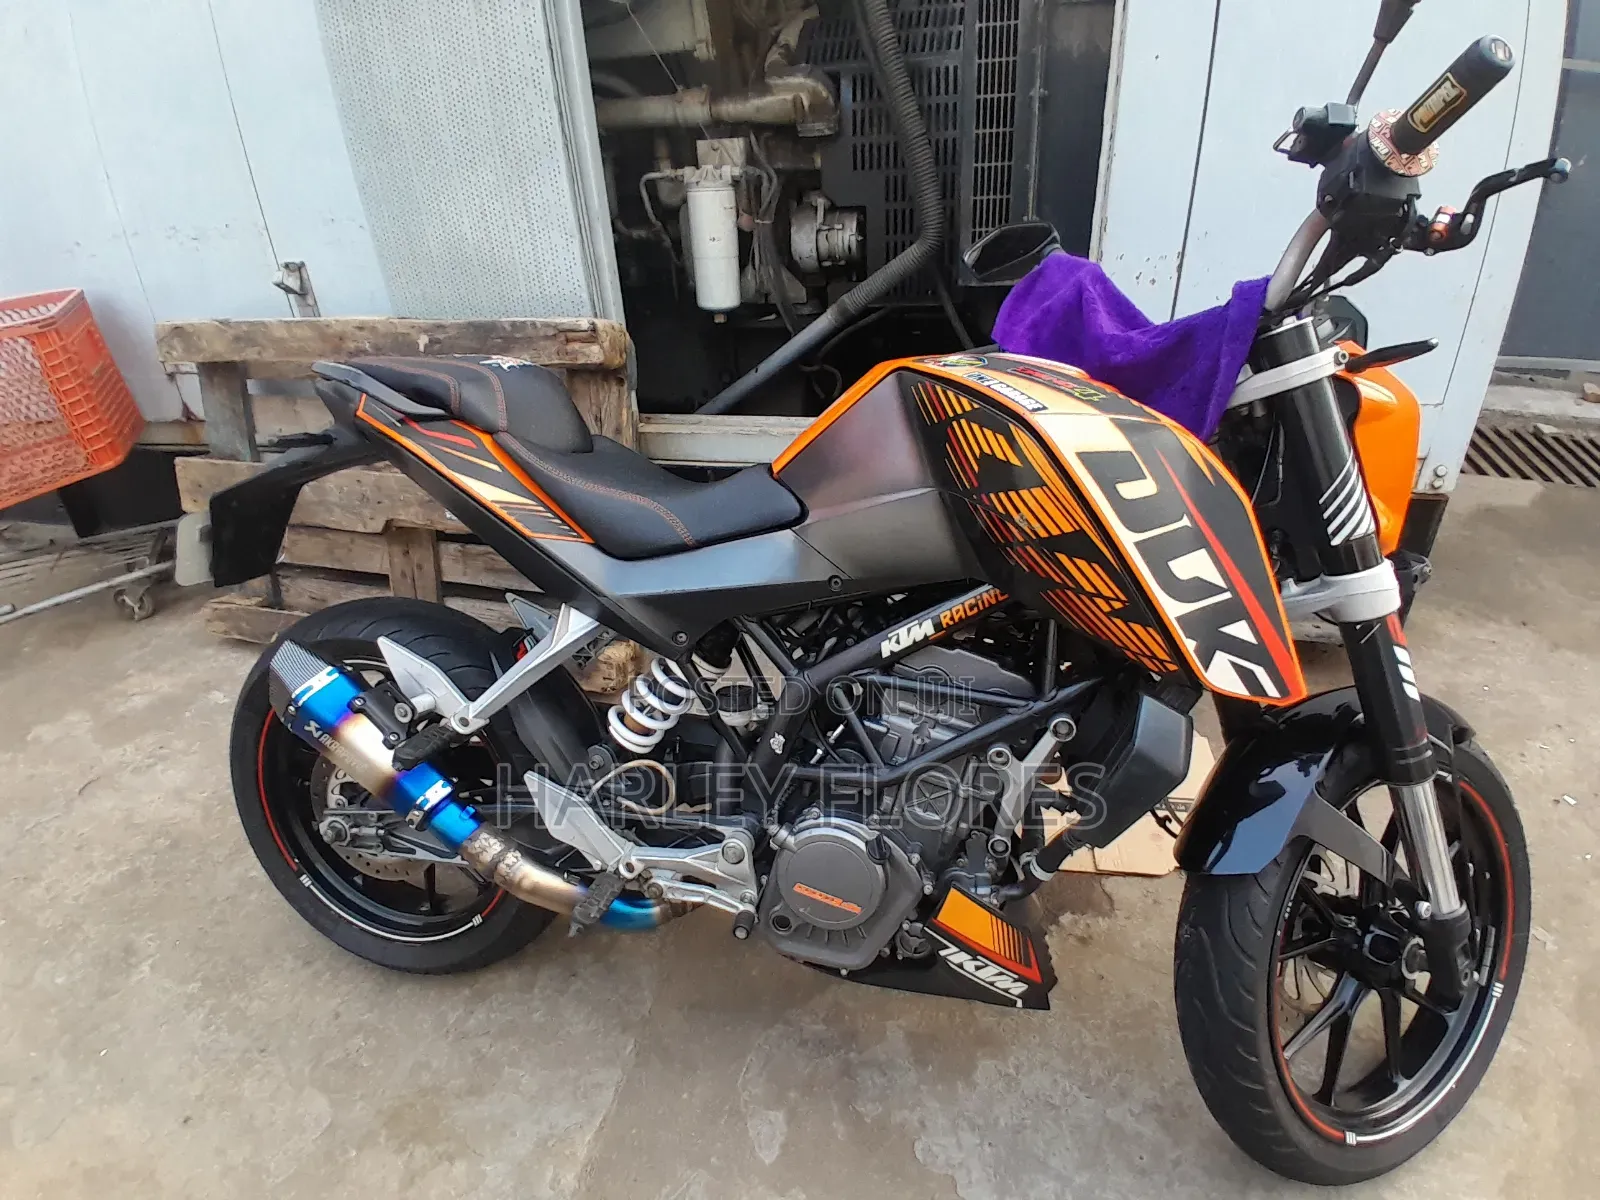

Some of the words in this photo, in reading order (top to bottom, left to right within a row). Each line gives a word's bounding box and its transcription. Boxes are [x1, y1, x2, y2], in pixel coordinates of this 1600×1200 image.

[1077, 440, 1284, 698] DUK
[880, 618, 936, 658] KTM
[944, 950, 1029, 997] KTM
